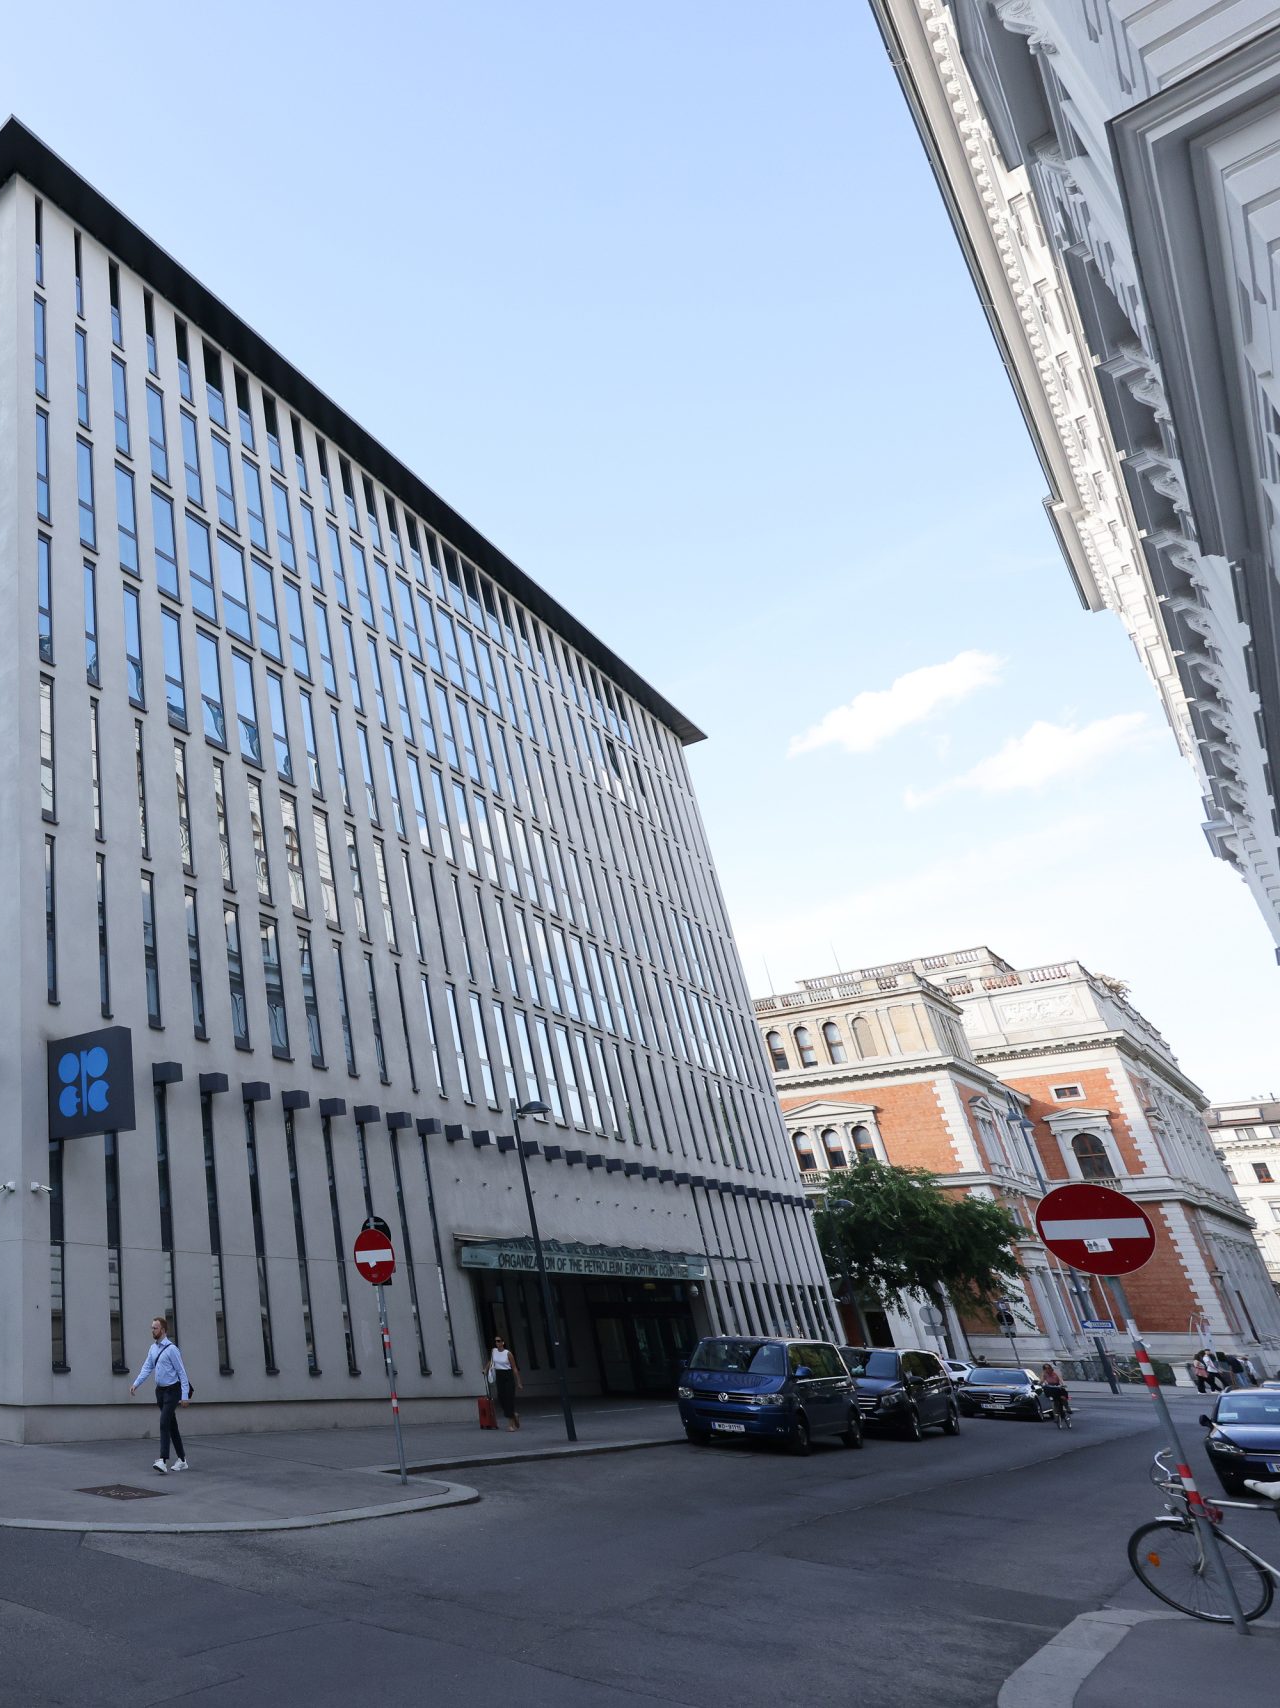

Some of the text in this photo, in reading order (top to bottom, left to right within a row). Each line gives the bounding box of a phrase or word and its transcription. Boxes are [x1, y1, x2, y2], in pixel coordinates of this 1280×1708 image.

[498, 1252, 556, 1270] ORGANIZAON
[557, 1257, 567, 1271] OF
[569, 1258, 583, 1272] THE
[583, 1259, 623, 1275] PETROLEUM
[625, 1262, 658, 1277] EXPORTING
